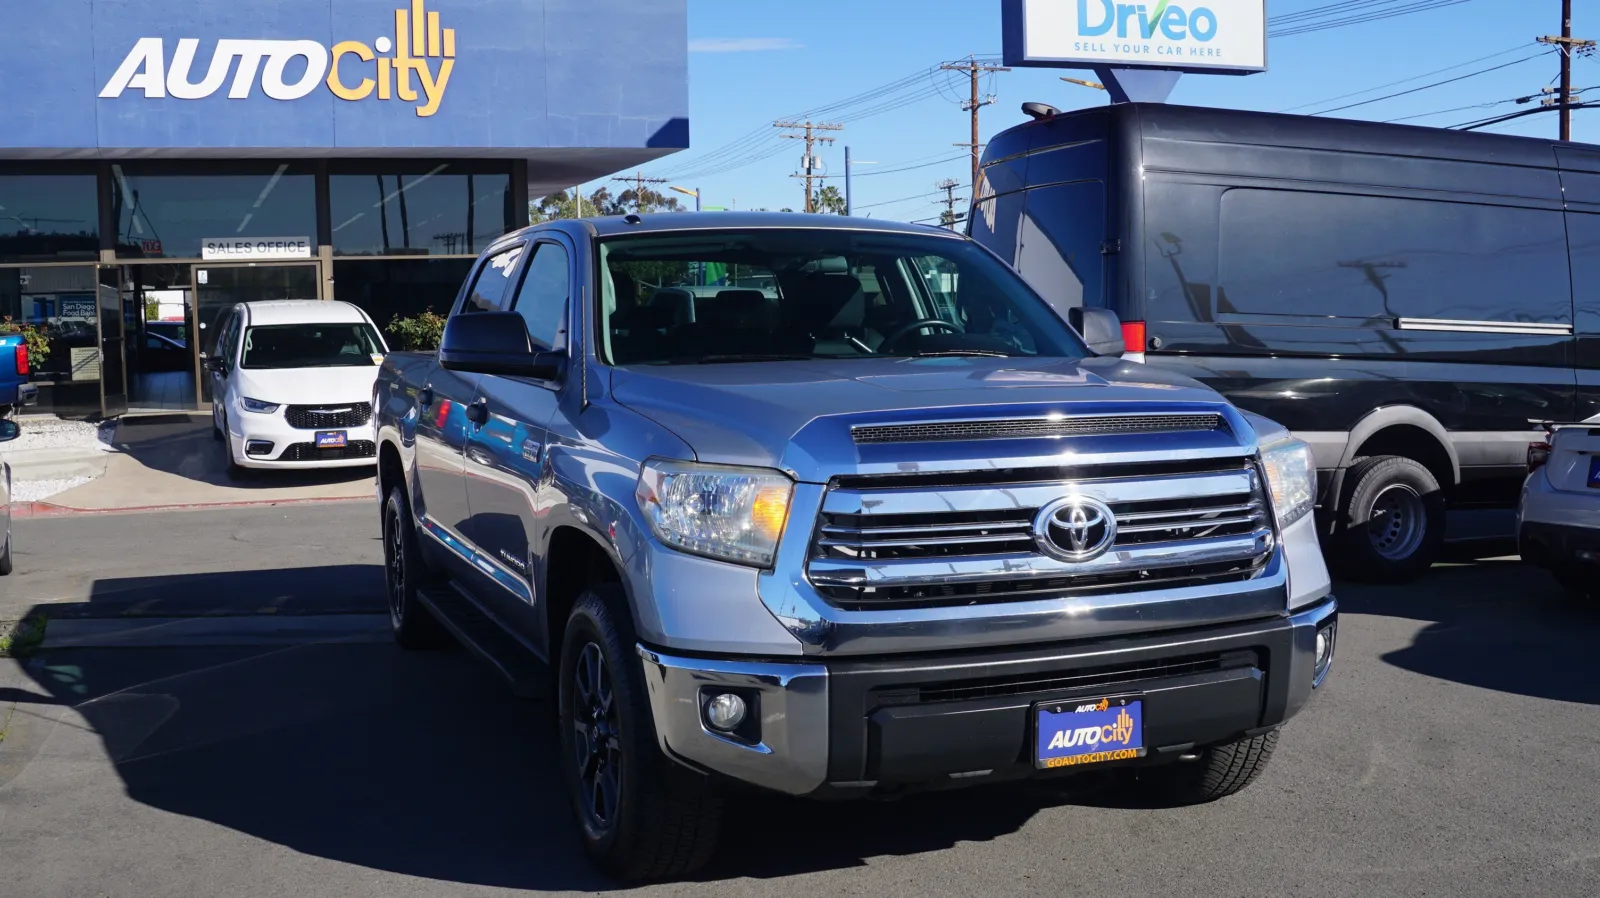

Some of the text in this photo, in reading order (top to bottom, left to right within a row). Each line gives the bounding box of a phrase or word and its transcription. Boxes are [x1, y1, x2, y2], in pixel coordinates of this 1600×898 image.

[1077, 0, 1218, 42] Driveo
[1074, 42, 1222, 57] SELL YOUR CAR HERE
[207, 241, 305, 254] SALES OFFICE
[76, 303, 95, 311] Diego
[1046, 749, 1137, 768] GOAUTOCITY.COM
